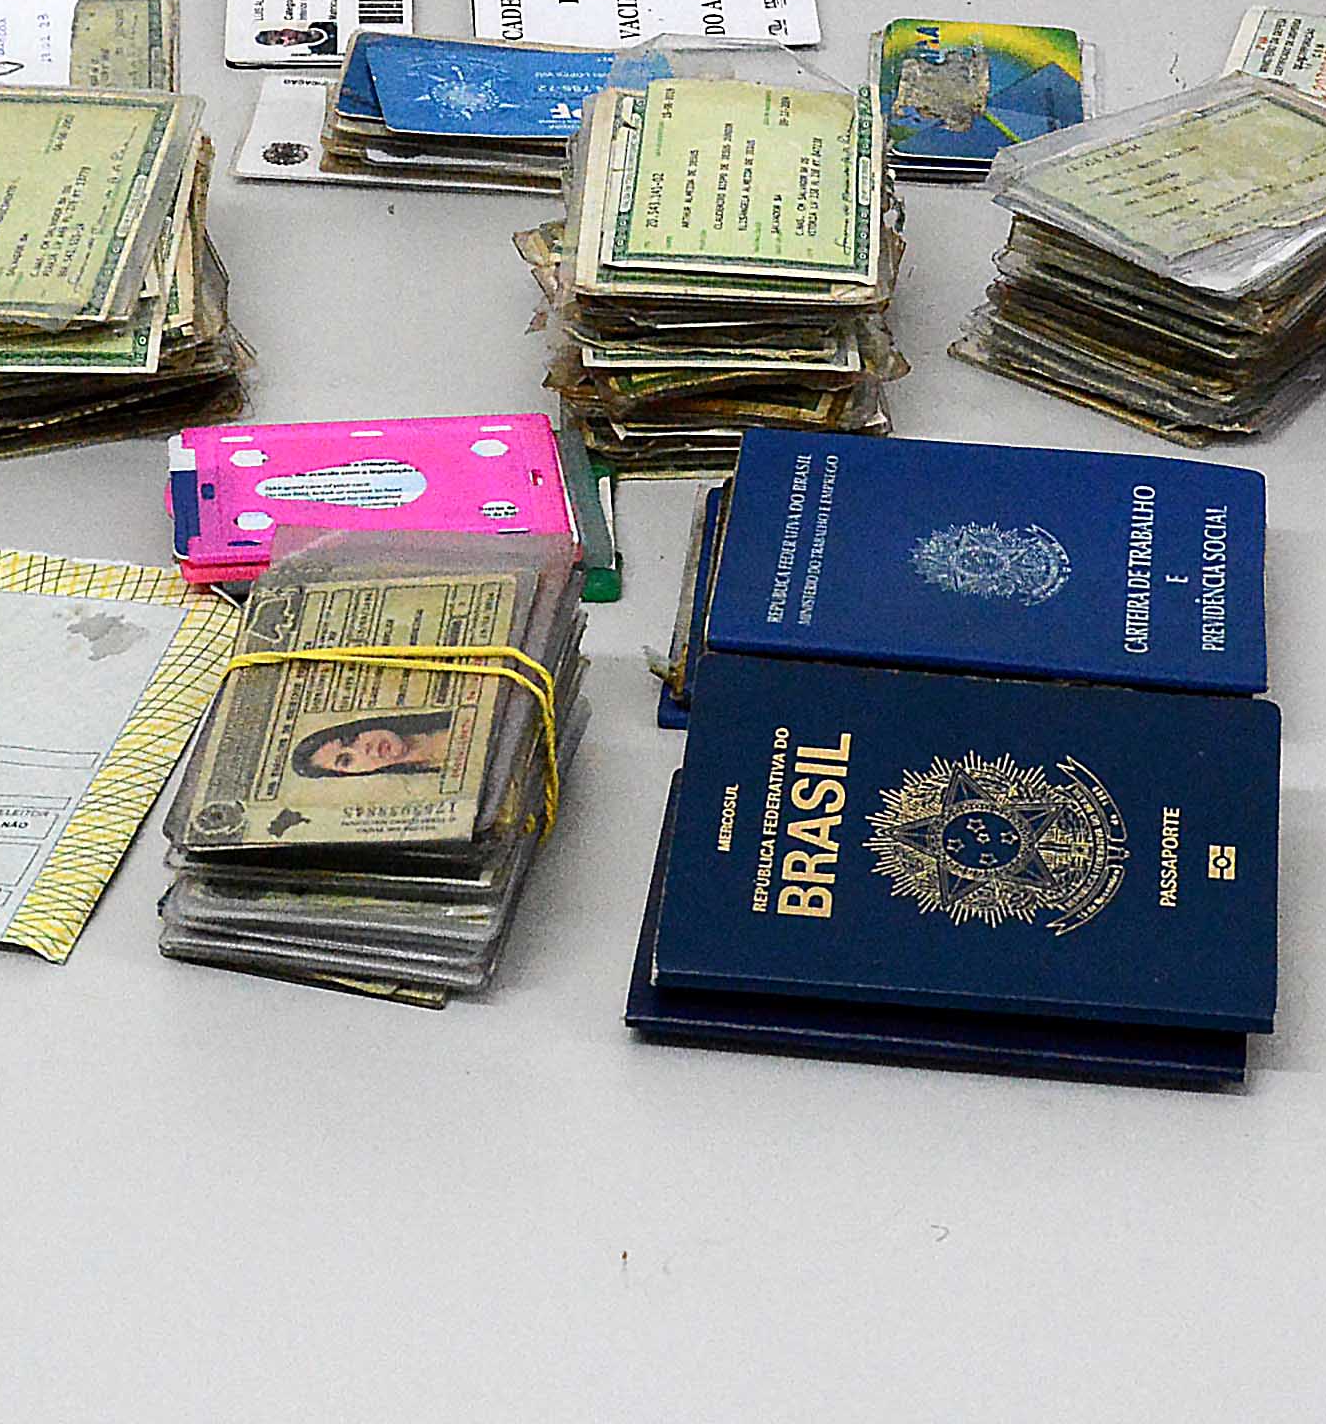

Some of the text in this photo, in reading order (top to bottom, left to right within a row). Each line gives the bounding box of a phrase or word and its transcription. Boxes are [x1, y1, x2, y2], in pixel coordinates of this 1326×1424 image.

[703, 13, 726, 35] DO
[792, 453, 812, 492] BRASIL
[788, 493, 805, 512] DO
[807, 560, 822, 574] DO
[1124, 485, 1155, 653] CARTEIRA DE TRABALHO
[1165, 574, 1188, 583] E
[1194, 505, 1227, 651] PREVIDÊNCIA SOCIAL
[1, 819, 29, 829] NÃO
[717, 783, 739, 852] MERCOSUL
[752, 727, 790, 912] REPÚBLICA FEDERATIVA DO
[777, 733, 851, 918] BRASIL
[1159, 806, 1180, 907] PASSAPORTE
